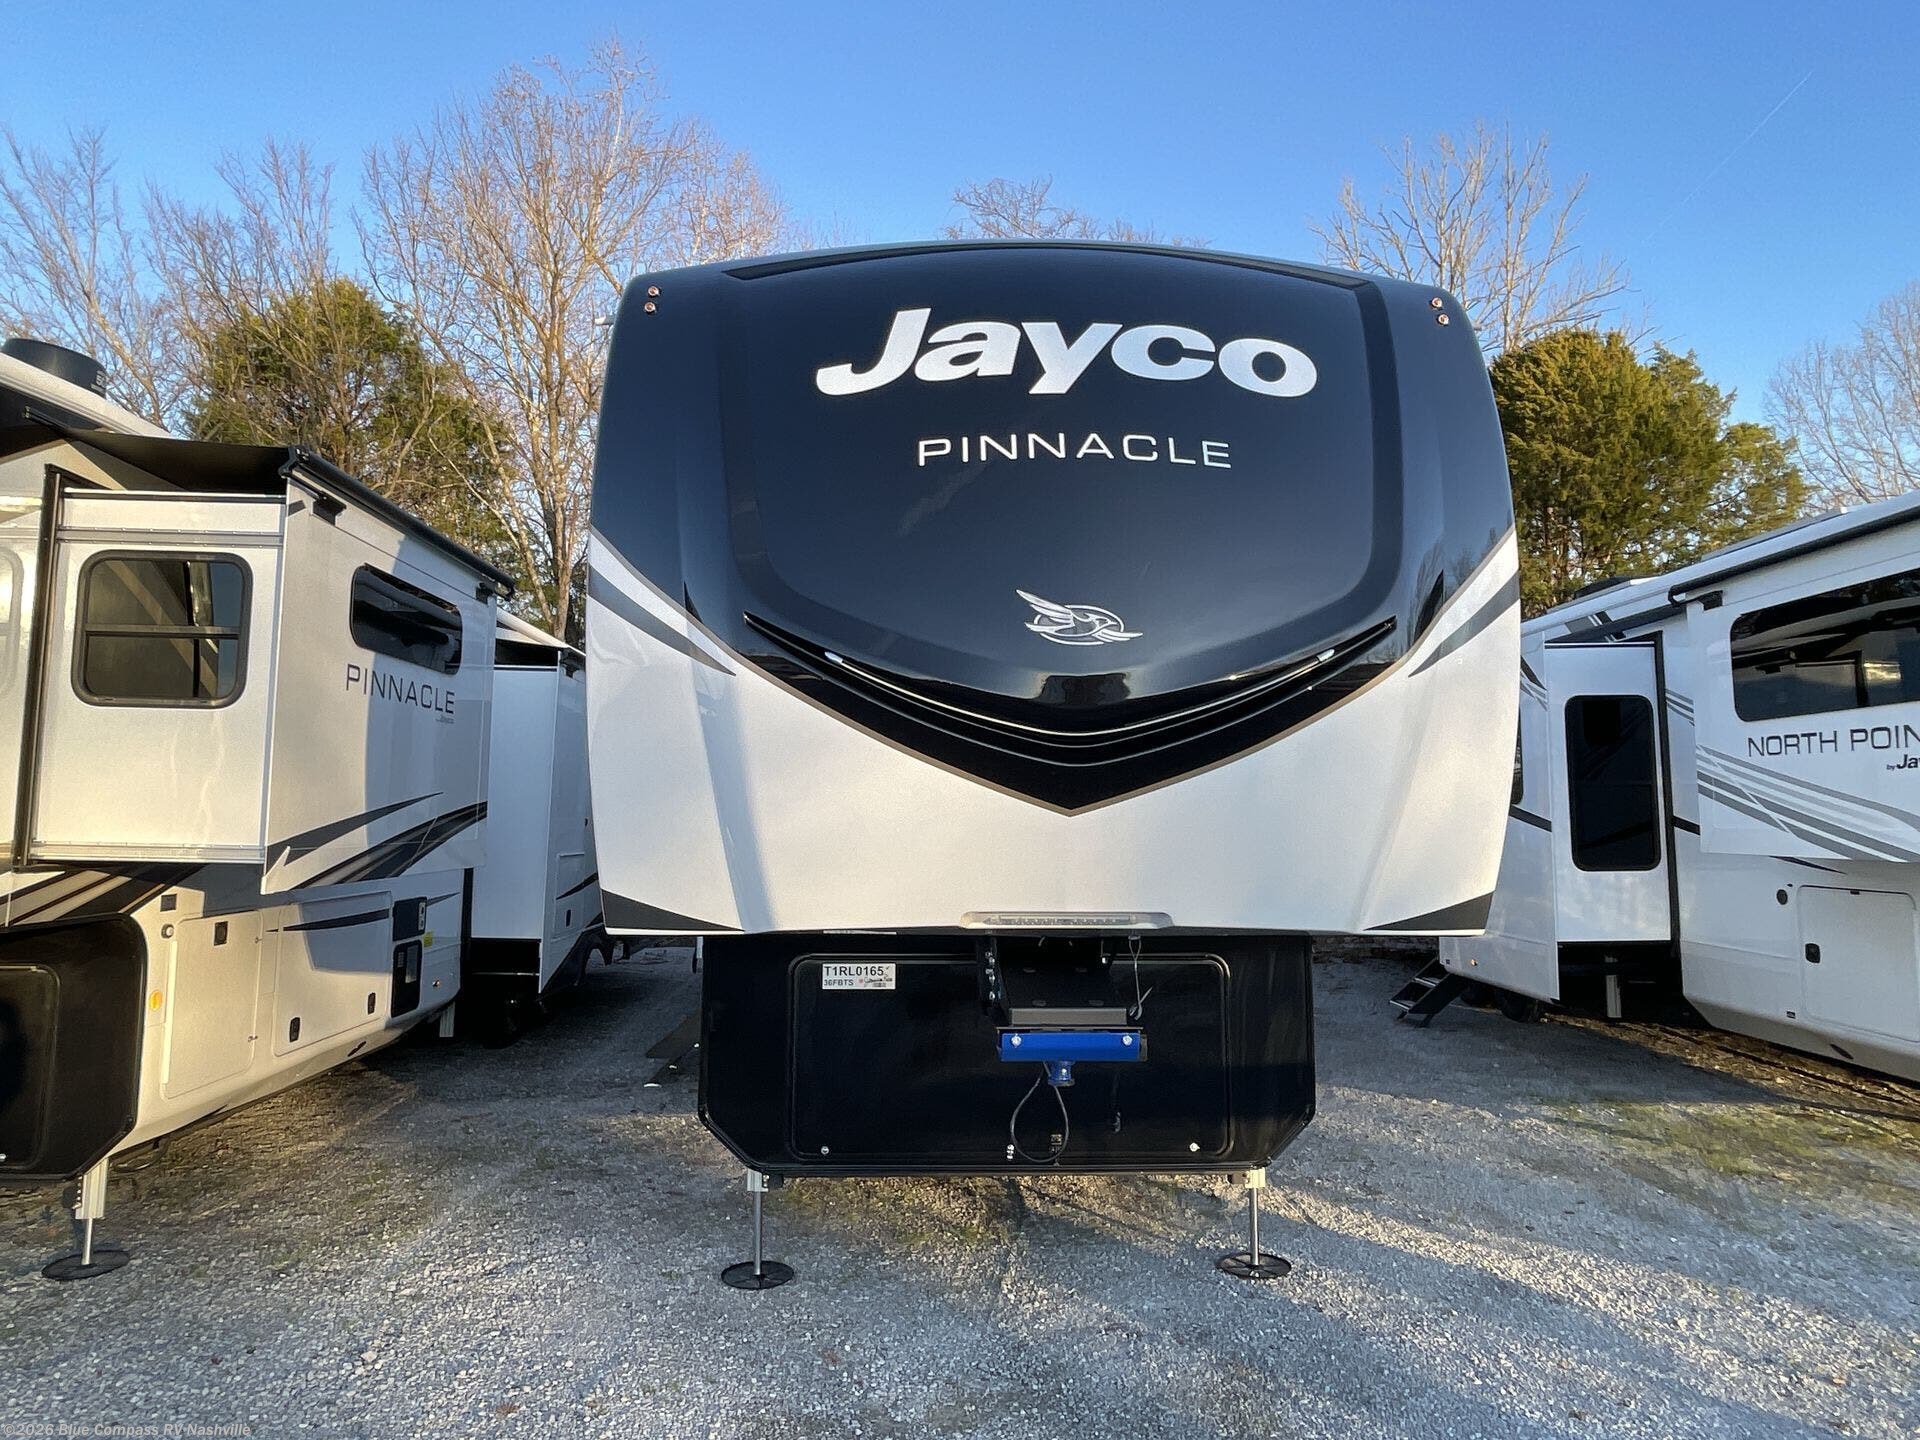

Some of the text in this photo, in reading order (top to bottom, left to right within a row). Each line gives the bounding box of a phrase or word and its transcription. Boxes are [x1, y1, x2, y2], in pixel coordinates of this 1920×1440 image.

[816, 308, 1317, 397] Jayco
[918, 432, 1232, 469] PINNACLE
[345, 663, 455, 714] PINNACLE
[1748, 724, 1920, 757] NORTH POIN
[1896, 754, 1920, 769] Ja
[824, 966, 884, 976] T1RL0165
